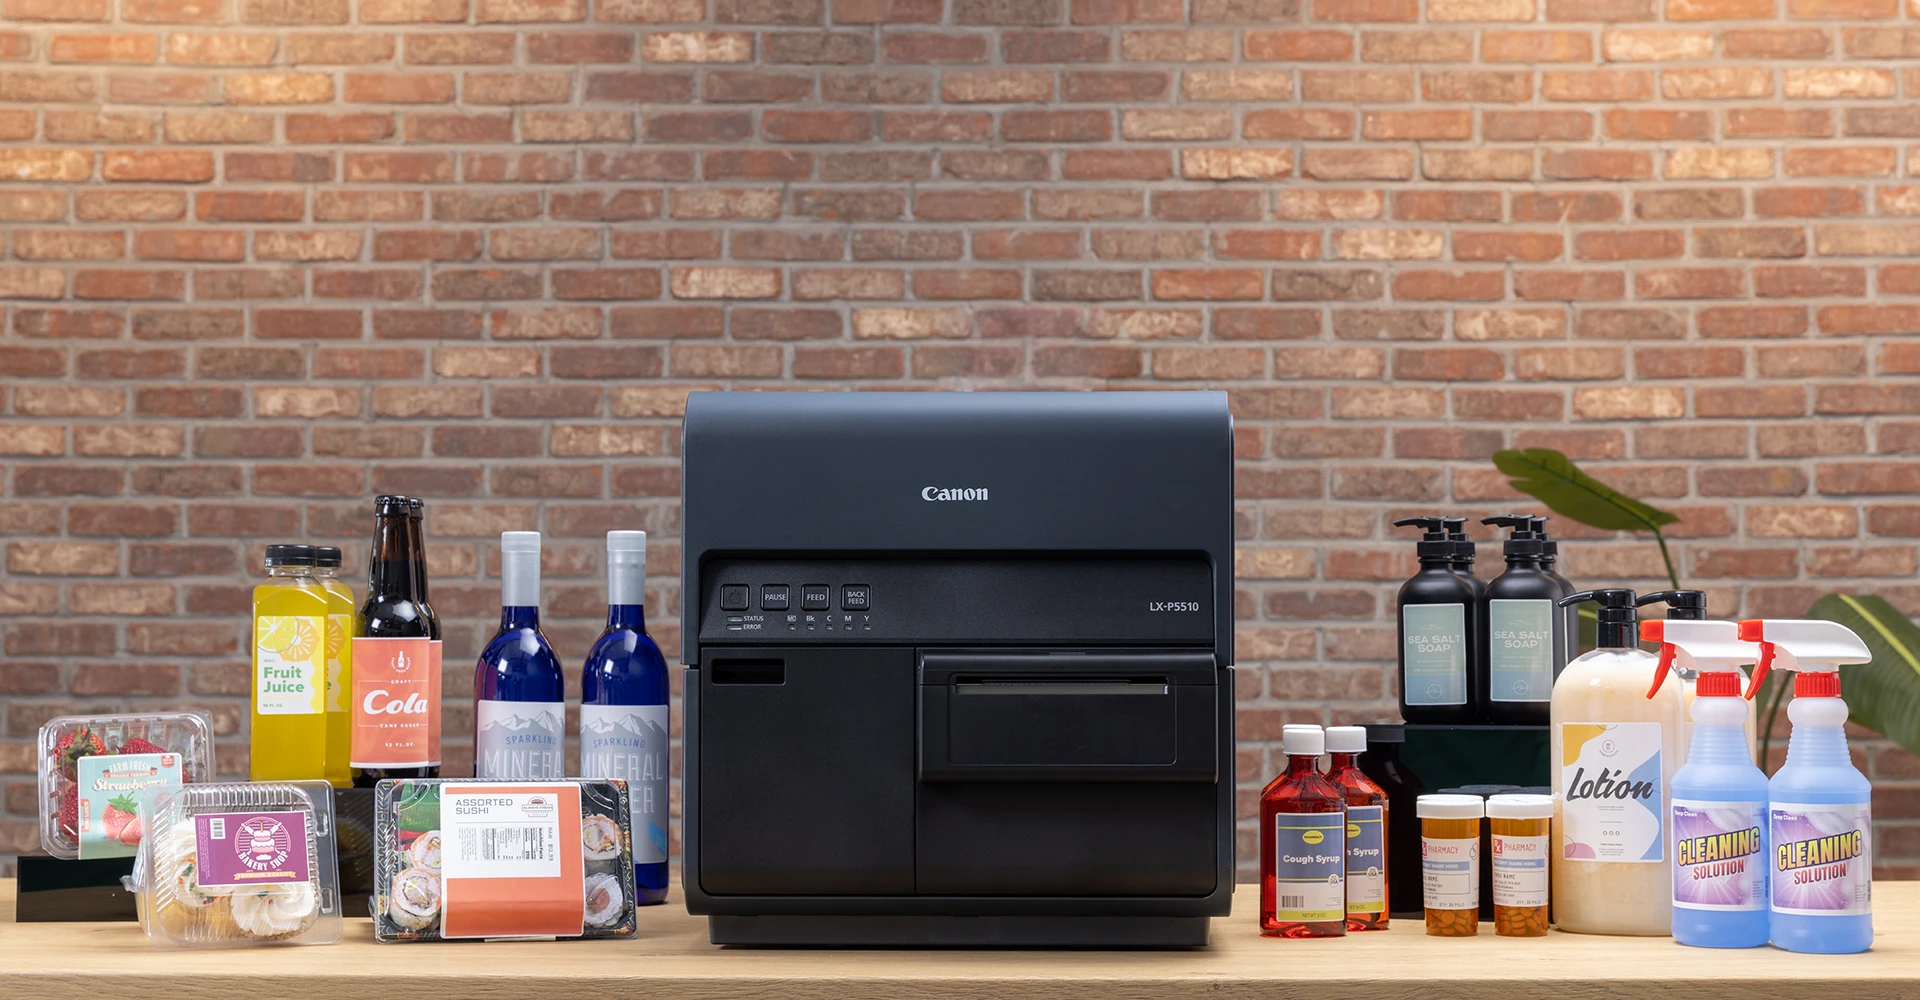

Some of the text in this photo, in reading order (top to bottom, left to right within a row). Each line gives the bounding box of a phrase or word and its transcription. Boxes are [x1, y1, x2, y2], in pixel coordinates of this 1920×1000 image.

[921, 486, 988, 501] Canon
[764, 593, 787, 601] PAUSE
[806, 593, 826, 601] FEED
[1149, 601, 1200, 611] LX-P5510
[1407, 634, 1462, 644] SEA SALT
[1494, 630, 1549, 639] SEA SALT
[1417, 643, 1451, 653] SOAP
[1504, 640, 1538, 648] SOAP
[263, 665, 302, 679] Fruit
[262, 680, 305, 693] Juice
[363, 689, 428, 715] Cola
[505, 734, 557, 746] SPARKLING
[592, 737, 646, 749] SPARKLING
[109, 761, 129, 773] FARM
[129, 760, 152, 771] FRESH
[484, 748, 565, 778] MINERA
[1566, 767, 1654, 802] Lotion
[455, 798, 513, 807] ASSORTED
[455, 807, 489, 815] SUSHI
[1353, 848, 1380, 857] Syrup
[1428, 845, 1459, 854] PHARMACY
[1504, 842, 1537, 852] PHARMACY
[1678, 826, 1760, 867] CLEANING
[1777, 829, 1862, 871] CLEANING
[238, 850, 289, 870] BAKERY SHOP
[1282, 854, 1341, 864] Cough Syrup
[1693, 858, 1745, 880] SOLUTION
[1793, 863, 1846, 885] SOLUTION
